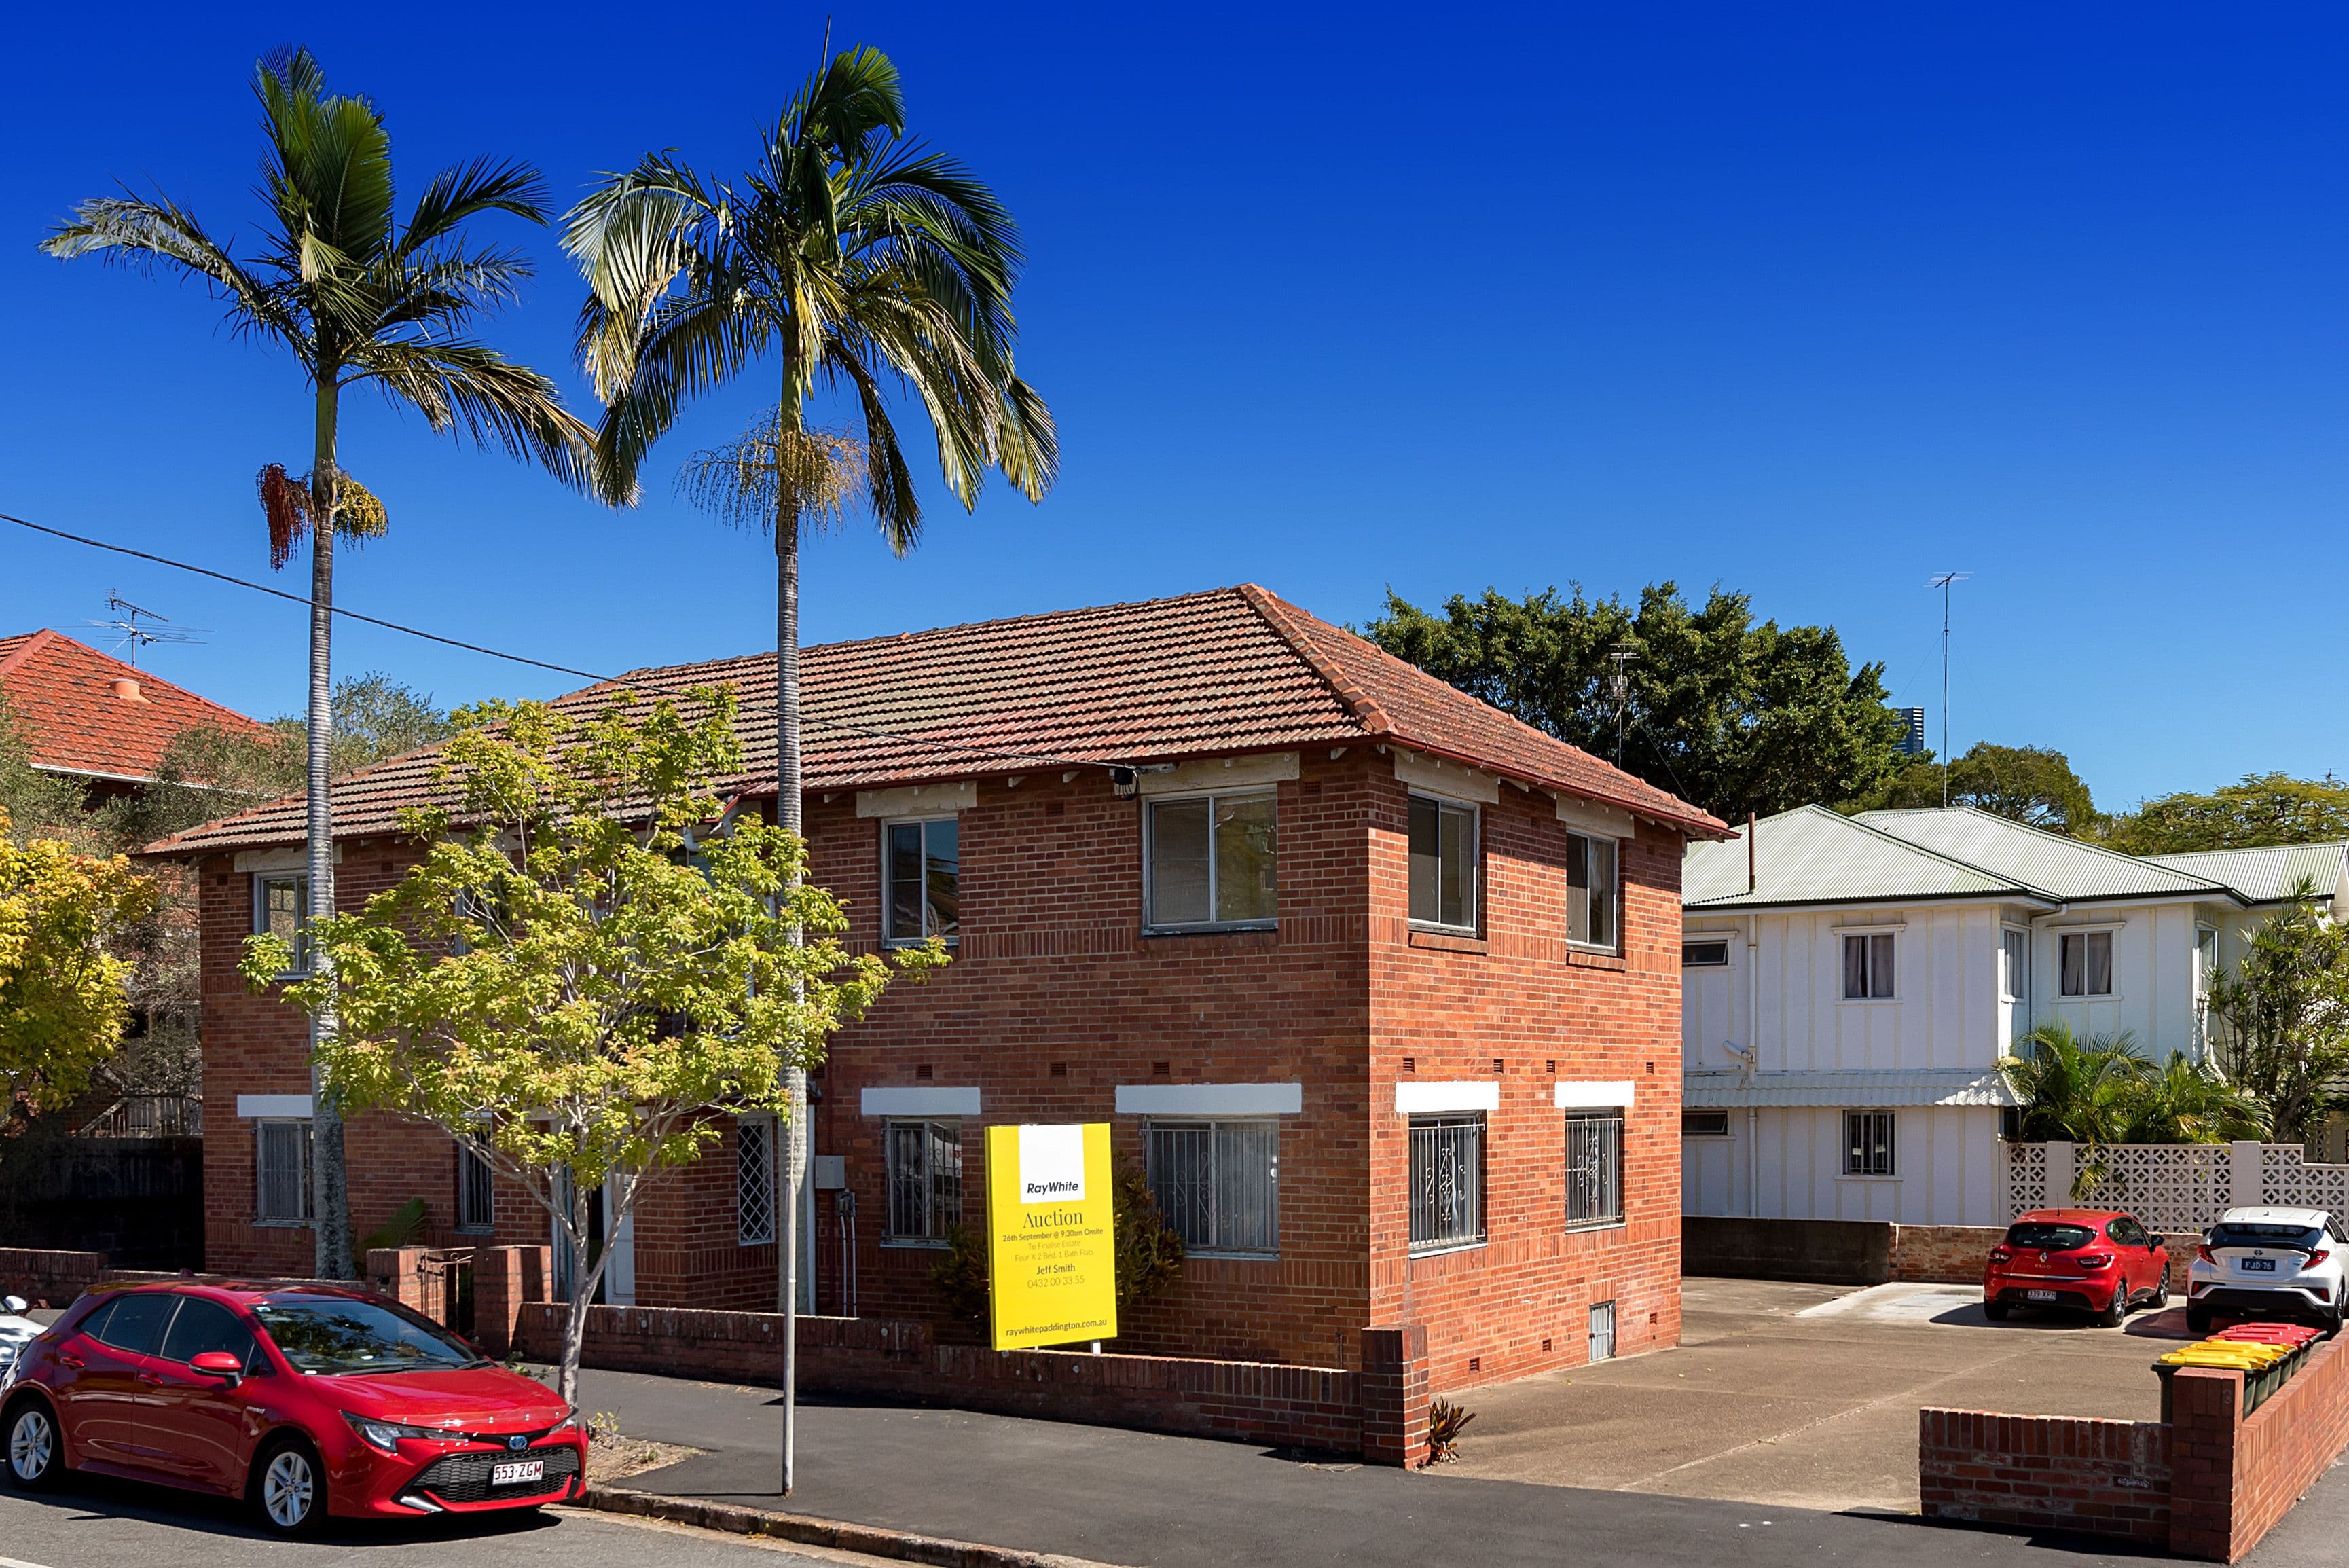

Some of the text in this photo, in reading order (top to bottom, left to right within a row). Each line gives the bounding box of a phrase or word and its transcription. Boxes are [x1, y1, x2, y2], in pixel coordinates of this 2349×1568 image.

[1023, 1209, 1083, 1228] Auction
[1002, 1233, 1017, 1242] 26th
[1019, 1232, 1052, 1241] September
[1036, 1264, 1076, 1275] Jeff Smith
[2263, 1262, 2272, 1270] 76
[1027, 1275, 1085, 1288] 0432 00 33 55
[2042, 1290, 2056, 1298] XPH
[1006, 1319, 1107, 1336] raywhitepaddington.com.au
